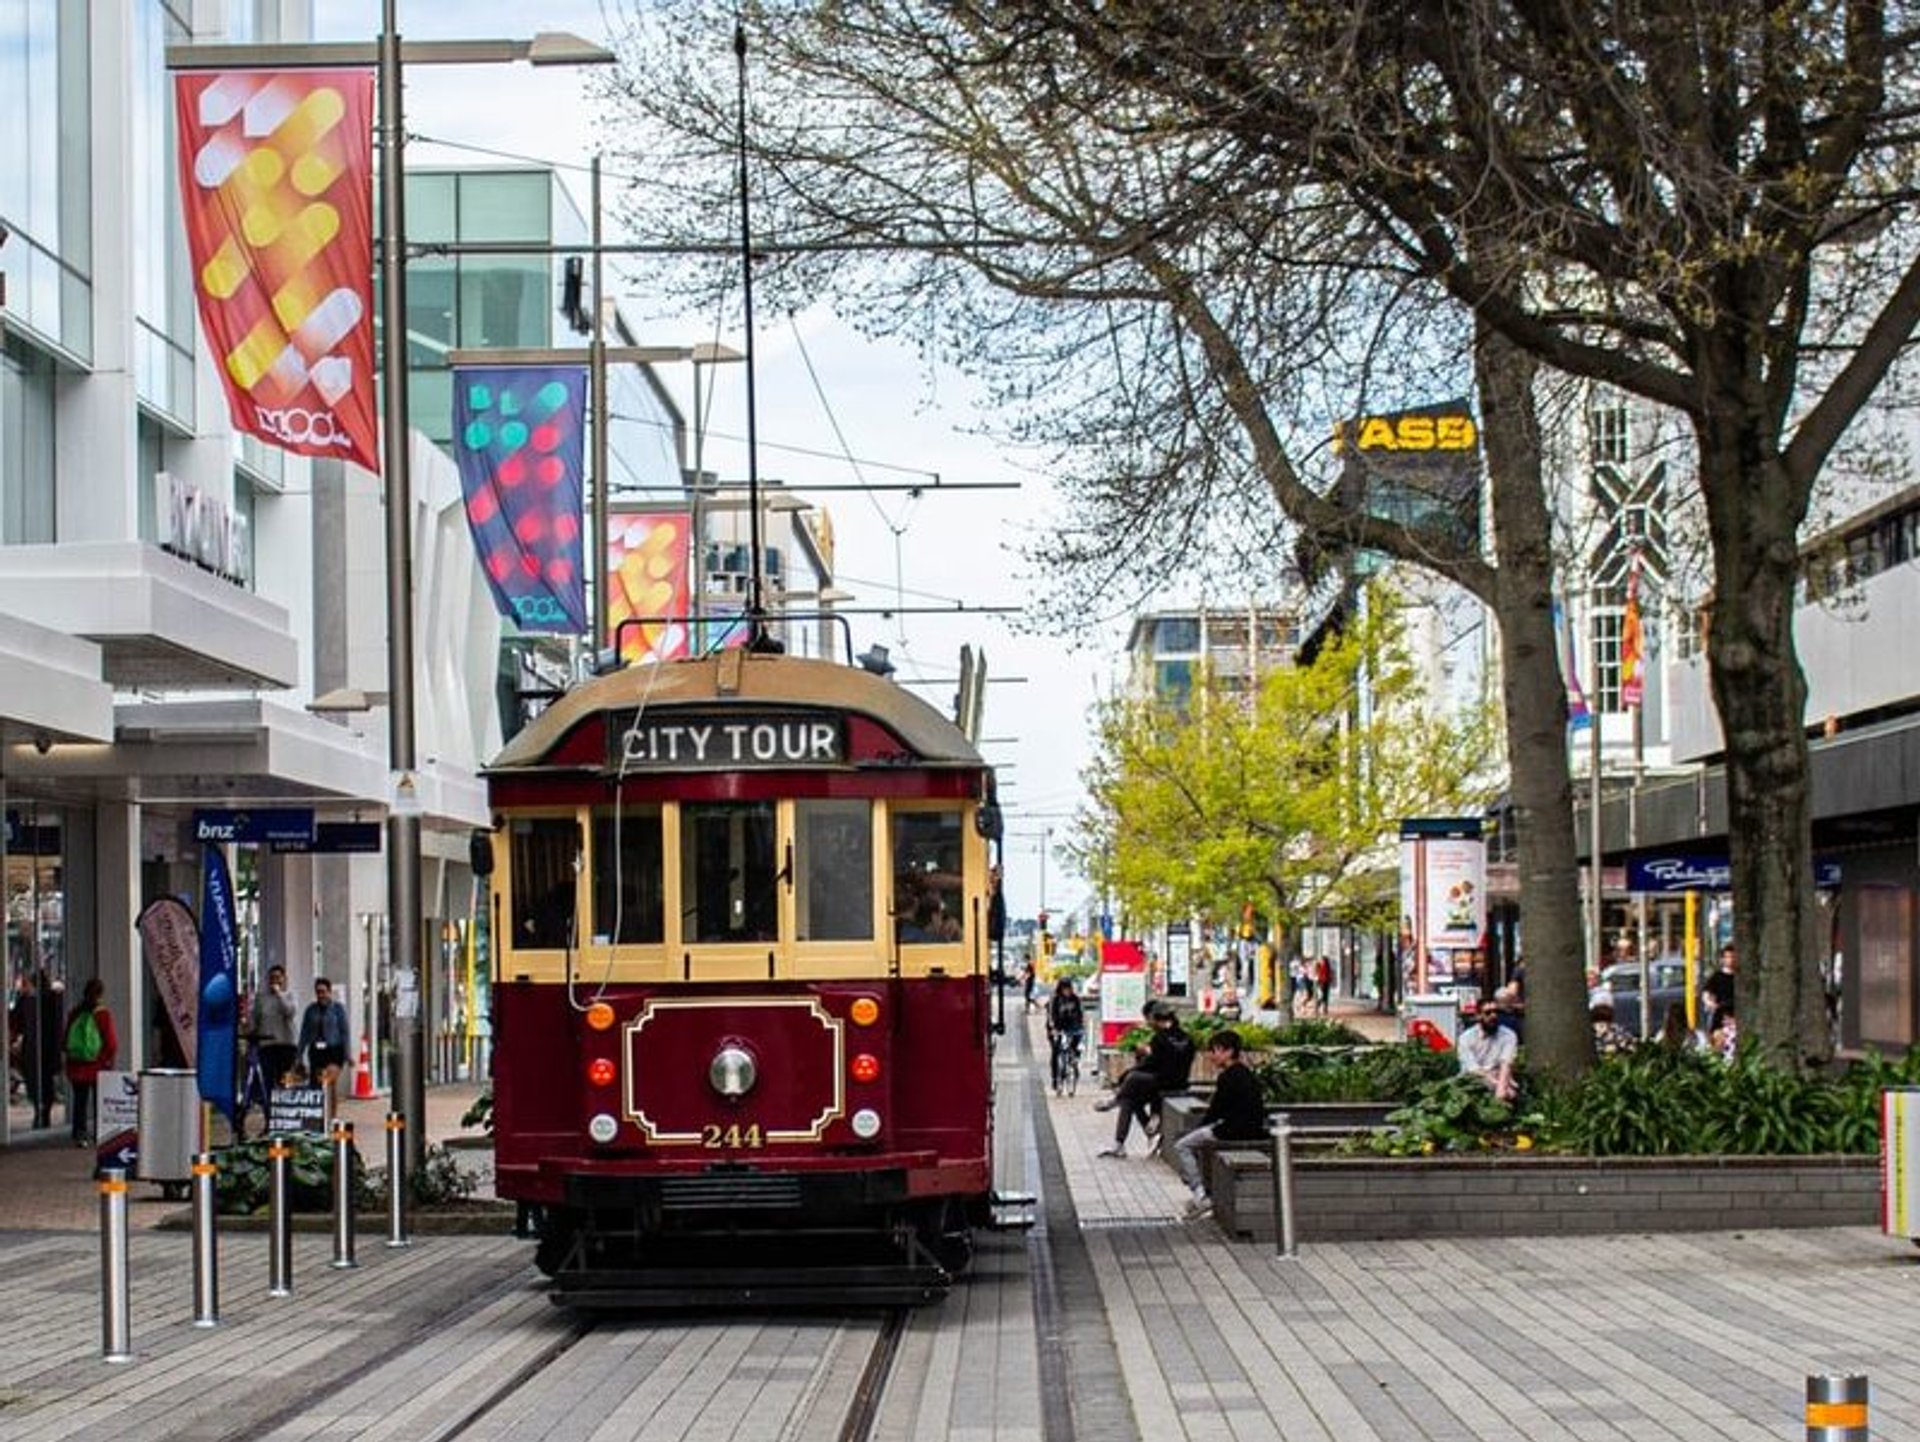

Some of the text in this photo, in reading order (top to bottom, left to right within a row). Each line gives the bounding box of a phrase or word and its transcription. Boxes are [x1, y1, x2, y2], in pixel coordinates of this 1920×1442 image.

[622, 724, 836, 760] CITY TOUR
[197, 819, 235, 839] bnz
[703, 1124, 763, 1148] 244
